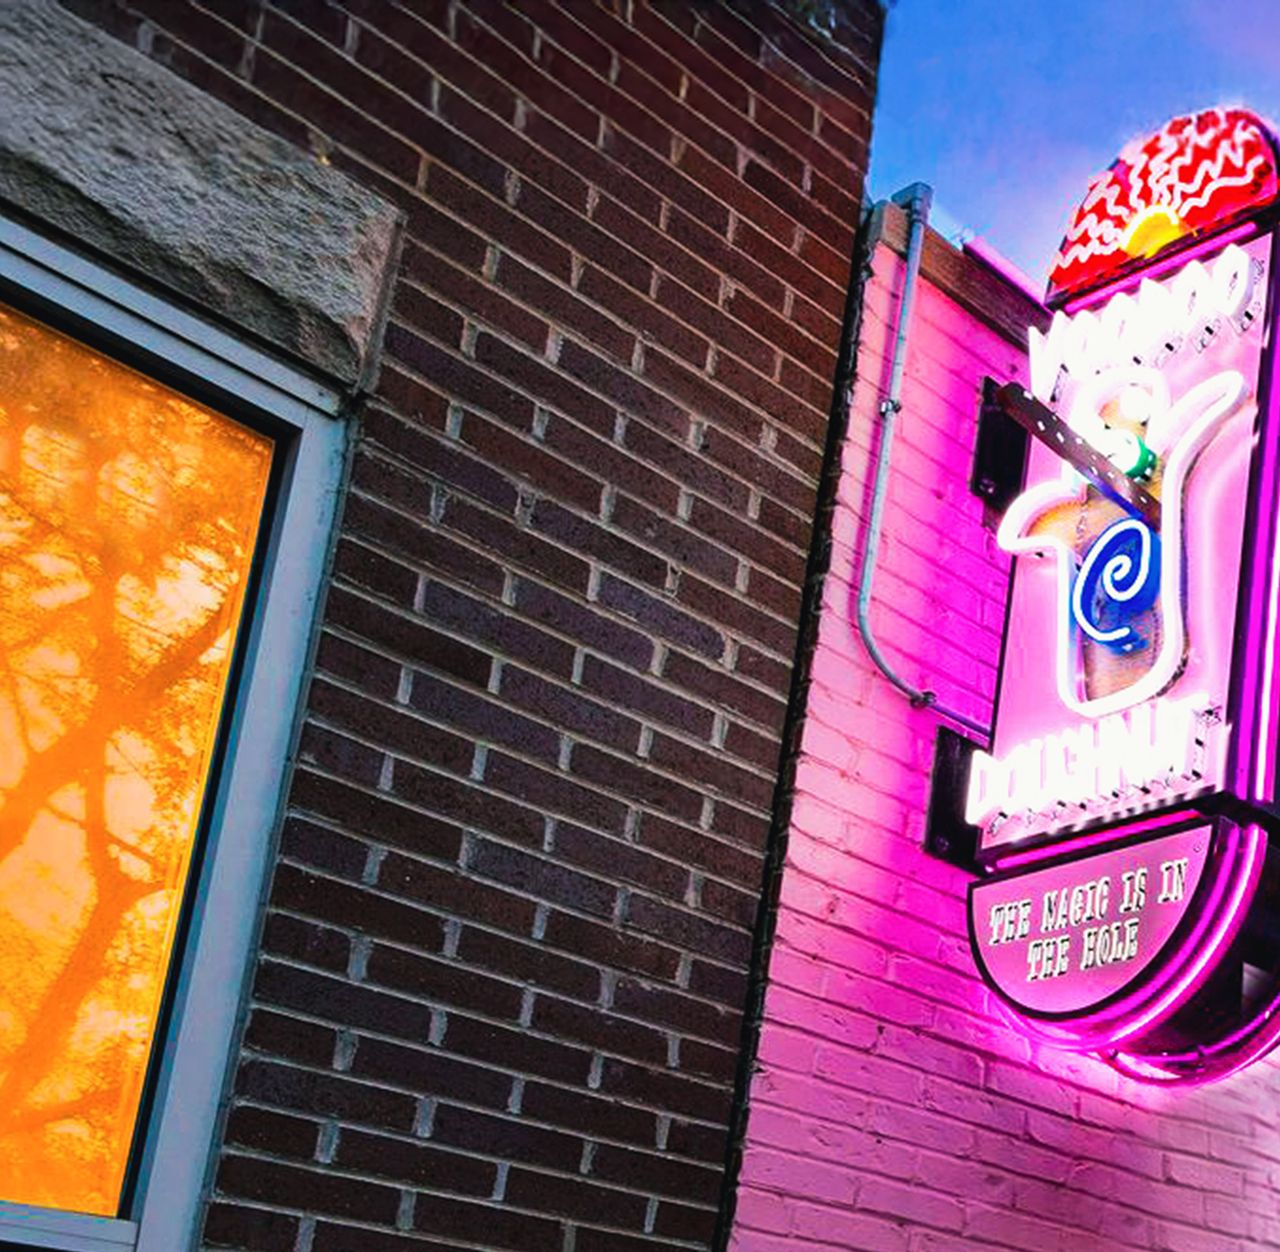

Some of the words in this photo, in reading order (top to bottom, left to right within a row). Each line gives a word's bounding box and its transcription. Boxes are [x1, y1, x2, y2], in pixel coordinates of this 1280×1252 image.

[988, 899, 1032, 945] THE
[1040, 877, 1110, 932] MAGIC
[1119, 867, 1148, 914] IS
[1158, 858, 1189, 904] IN
[1026, 934, 1070, 982] THE
[1080, 918, 1140, 971] HOLE
